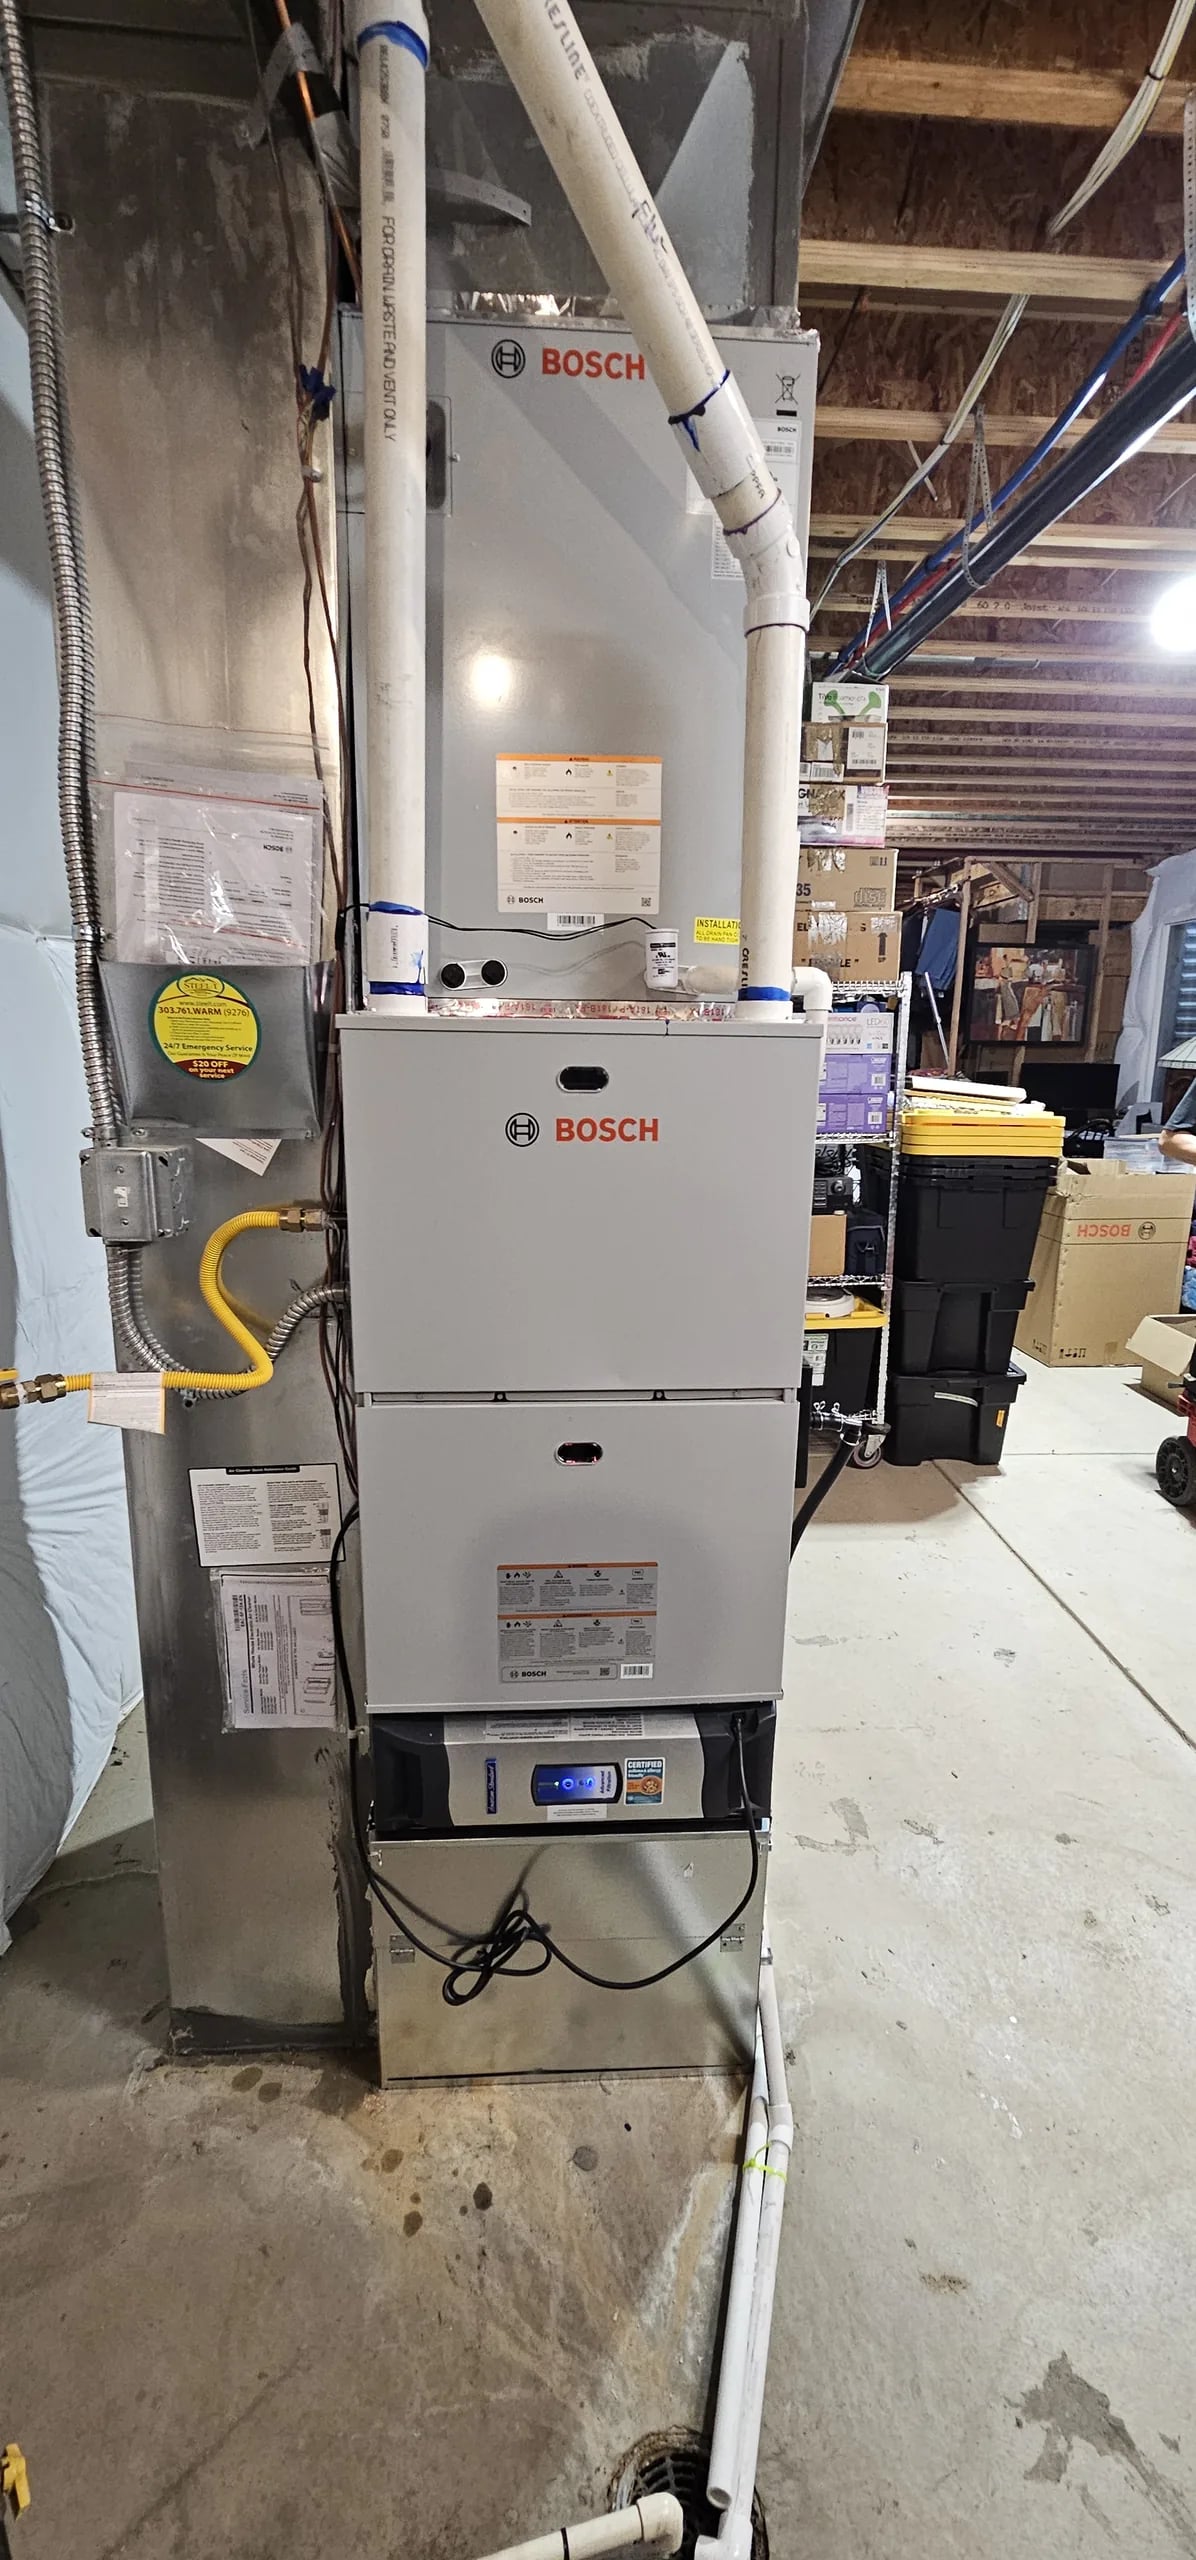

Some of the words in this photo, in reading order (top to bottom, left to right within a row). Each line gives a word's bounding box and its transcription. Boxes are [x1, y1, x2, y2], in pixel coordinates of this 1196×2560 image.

[381, 215, 395, 246] FOR
[383, 294, 397, 339] WASTE
[383, 340, 397, 368] AND
[541, 347, 646, 380] BOSCH
[384, 371, 397, 408] VENT
[384, 408, 398, 442] ONLY
[518, 896, 544, 904] BOSCH
[223, 1008, 250, 1017] (9276)
[163, 1042, 180, 1050] 24/7
[181, 1043, 224, 1052] Emergency
[225, 1044, 253, 1052] Service
[210, 1060, 229, 1068] OFF
[555, 1118, 659, 1142] BOSCH
[1077, 1223, 1132, 1238] BOSCH
[521, 1670, 547, 1678] BOSCH
[627, 1760, 663, 1769] CERTIFIED
